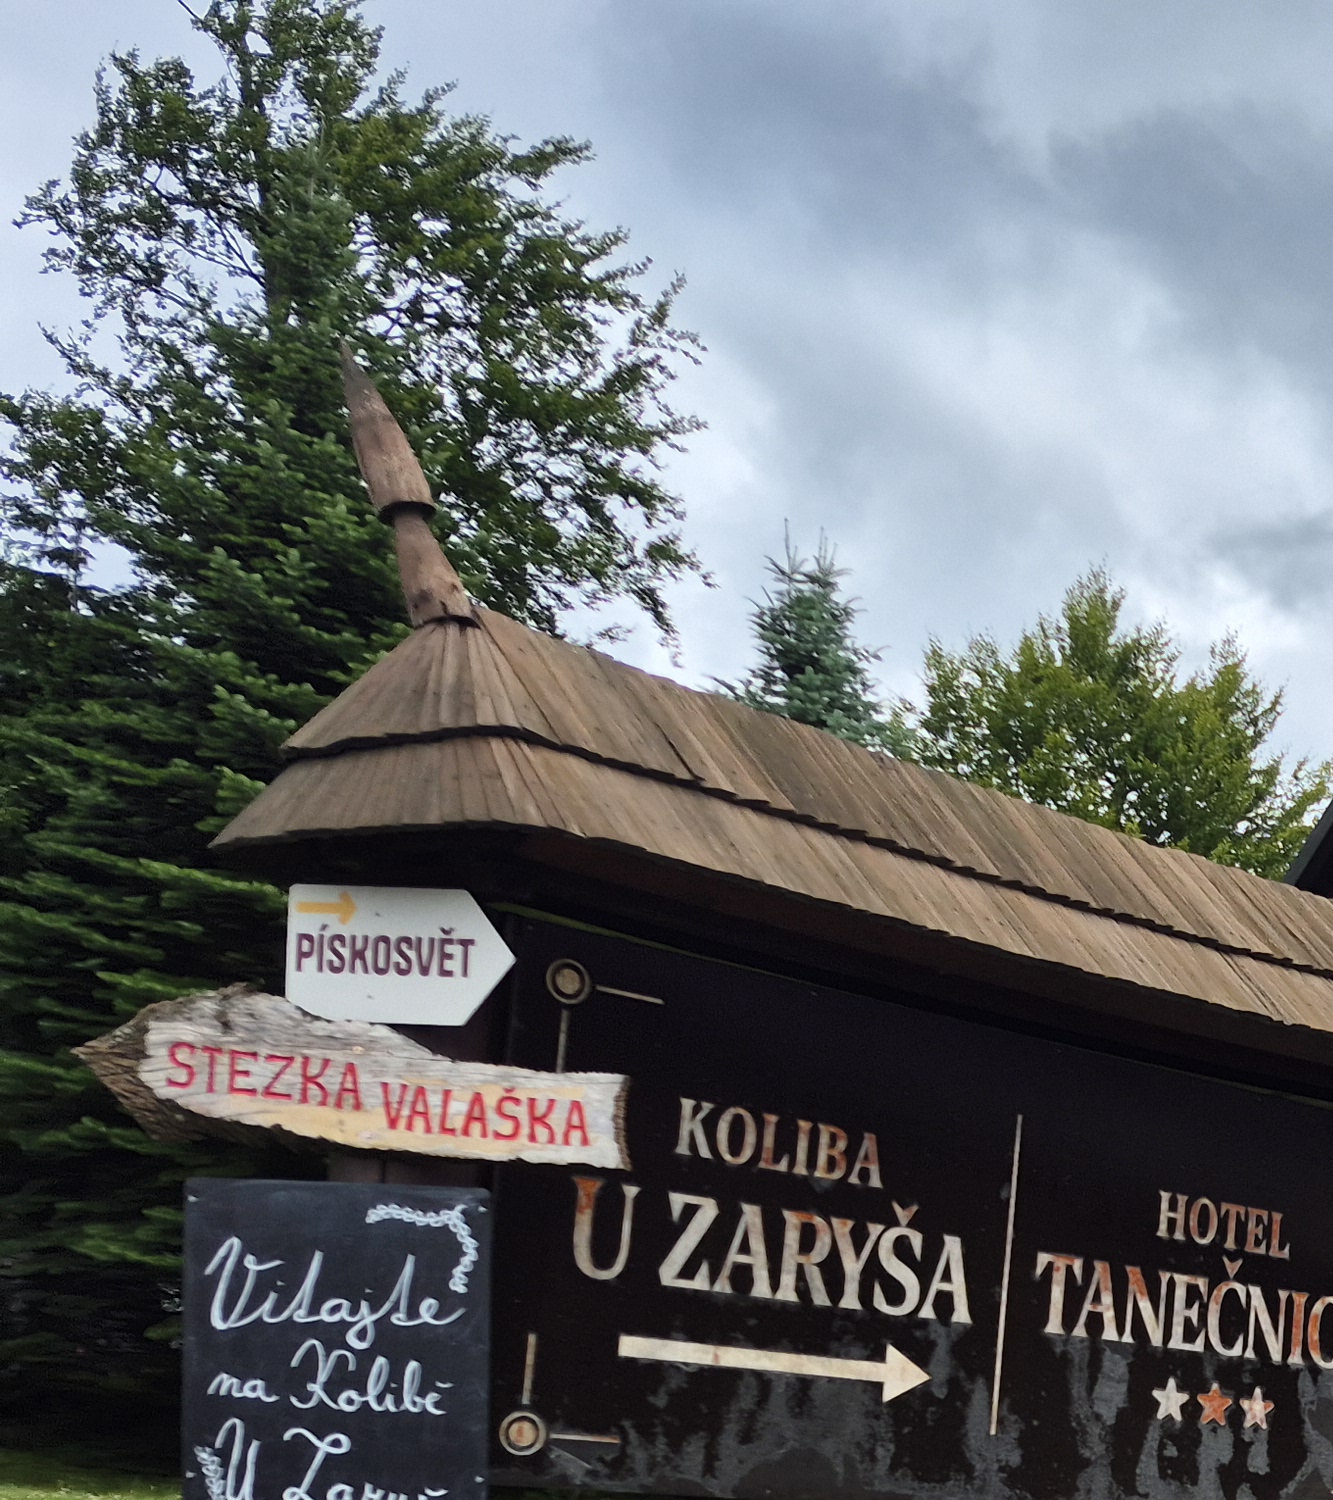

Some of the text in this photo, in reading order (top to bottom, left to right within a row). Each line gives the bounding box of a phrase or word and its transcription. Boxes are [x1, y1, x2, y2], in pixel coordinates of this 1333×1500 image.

[295, 924, 477, 979] PÍSKOSVĚT
[165, 1040, 591, 1147] STEZKA VALAŠKA
[675, 1097, 883, 1189] KOLIBA
[572, 1175, 973, 1325] U ZARYŠA
[1156, 1189, 1291, 1260] HOTEL
[207, 1372, 280, 1402] na
